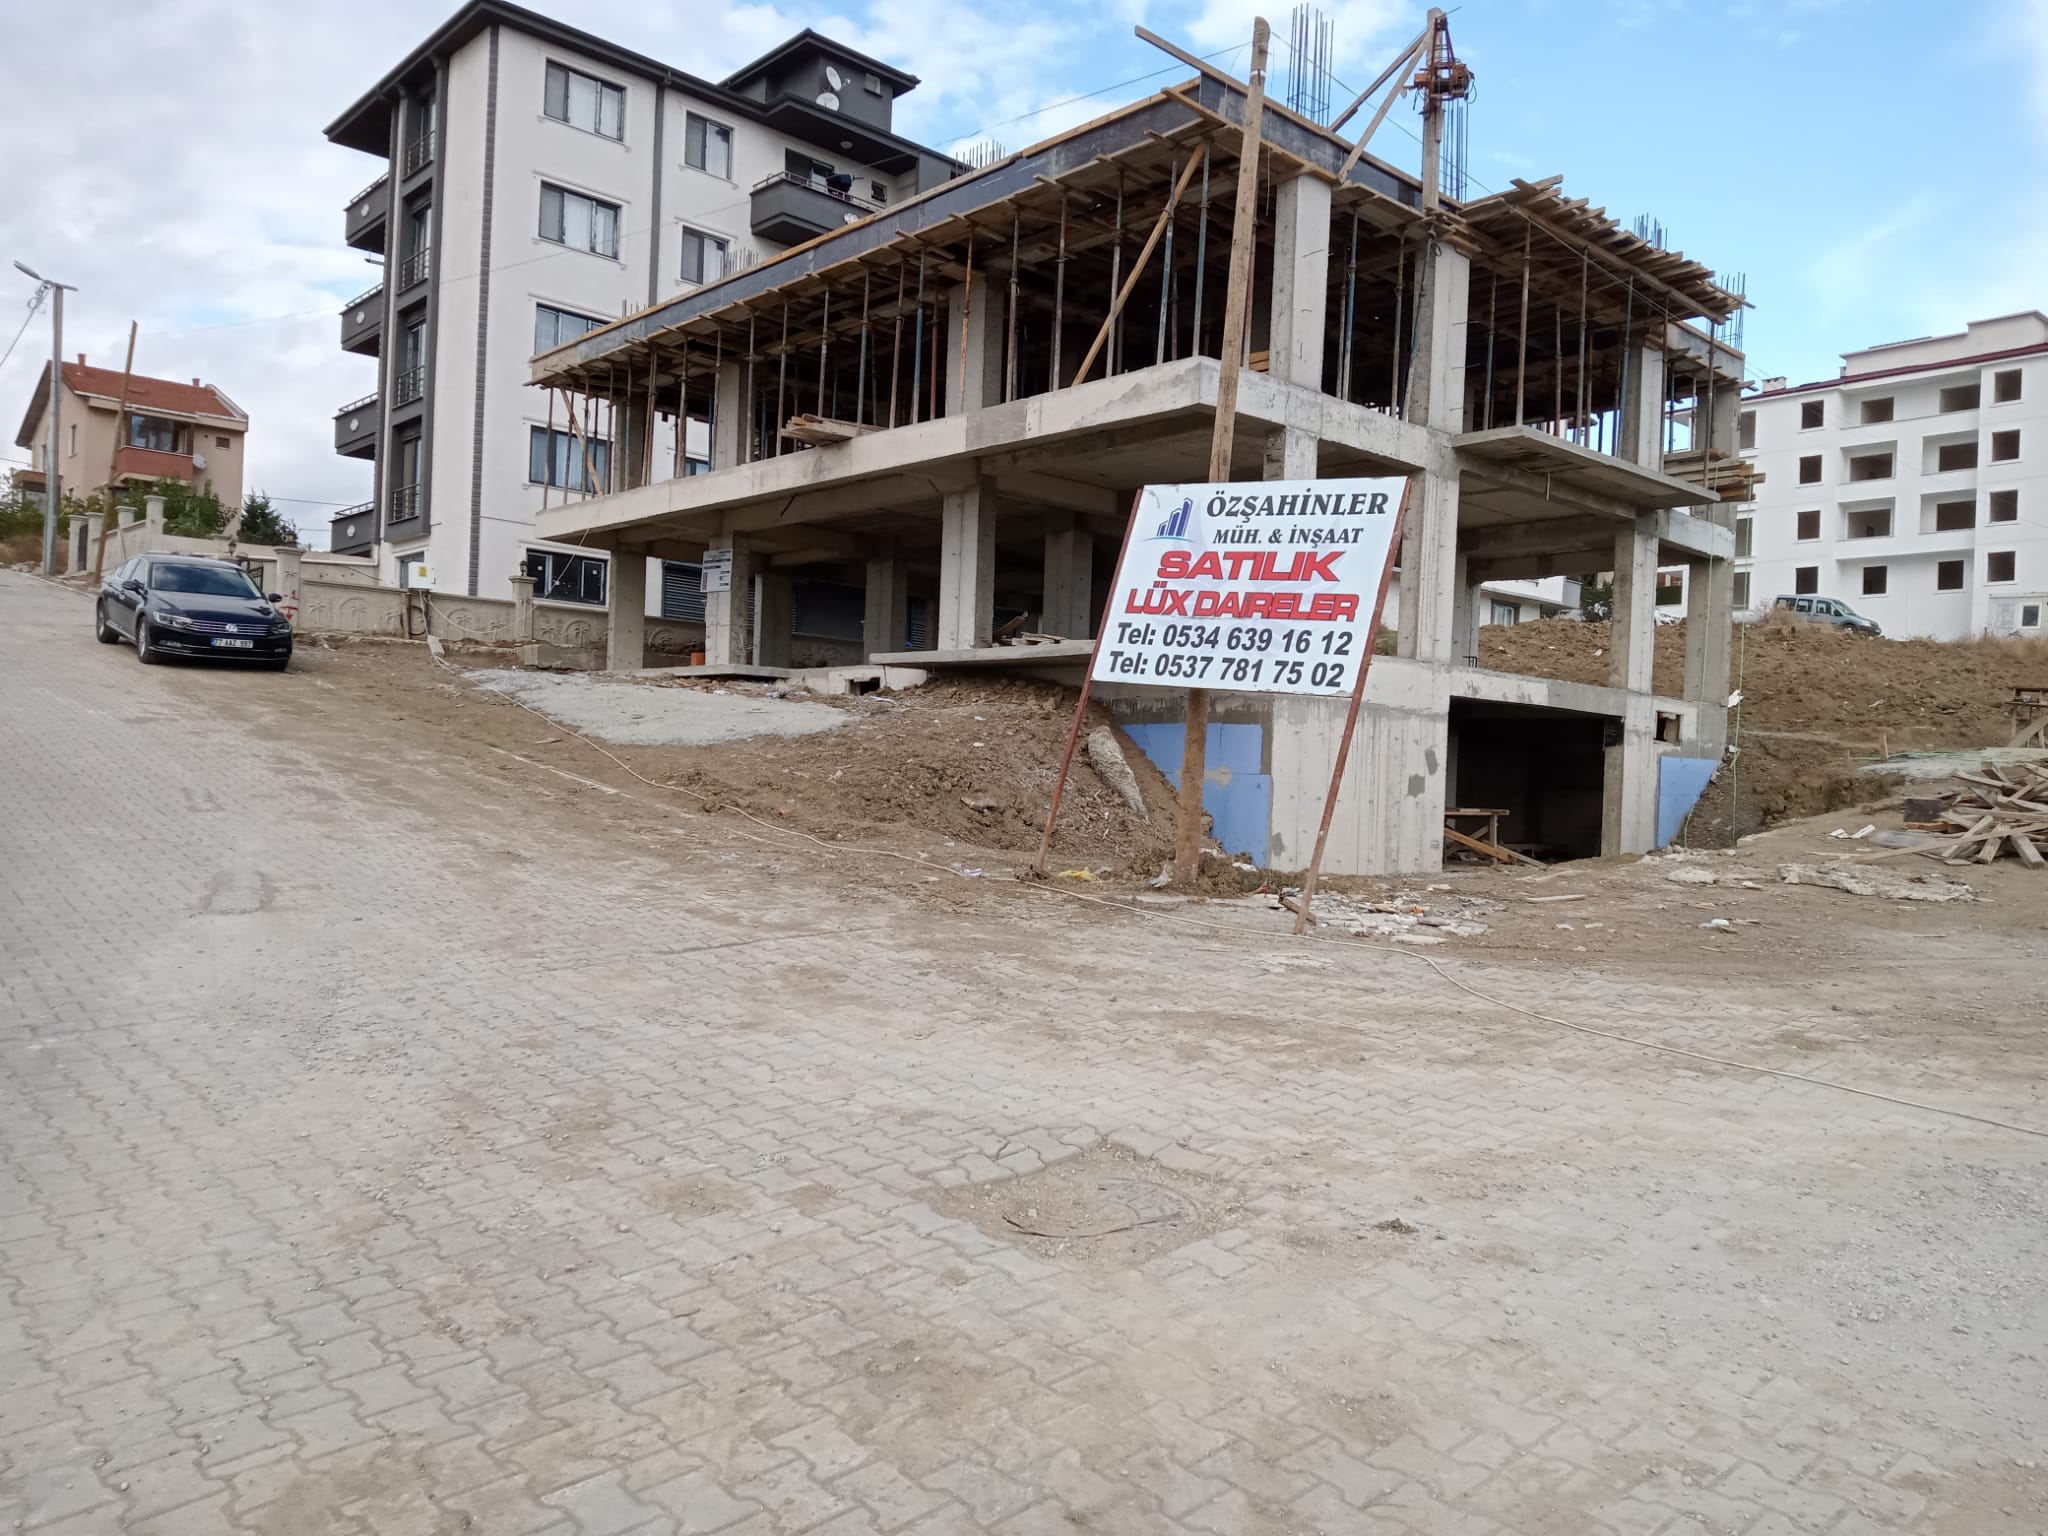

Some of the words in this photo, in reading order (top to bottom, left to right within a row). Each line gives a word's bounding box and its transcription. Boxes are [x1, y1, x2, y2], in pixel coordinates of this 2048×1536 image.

[1207, 488, 1389, 523] ÖZŞAHİNLER
[1213, 525, 1262, 544] MÜH.
[1268, 529, 1282, 544] &
[1288, 524, 1364, 548] İNŞAAT
[1157, 550, 1345, 582] SATILIK
[1125, 581, 1193, 616] LÜX
[1117, 622, 1155, 646] Tel:
[1162, 625, 1219, 649] 0534
[1227, 627, 1273, 652] 639
[1282, 629, 1312, 654] 16
[1321, 631, 1353, 656] 12
[1109, 651, 1147, 674] Tel:
[1154, 654, 1213, 679] 0537
[1220, 657, 1263, 682] 781
[1274, 660, 1303, 685] 75
[1311, 663, 1345, 688] 02
